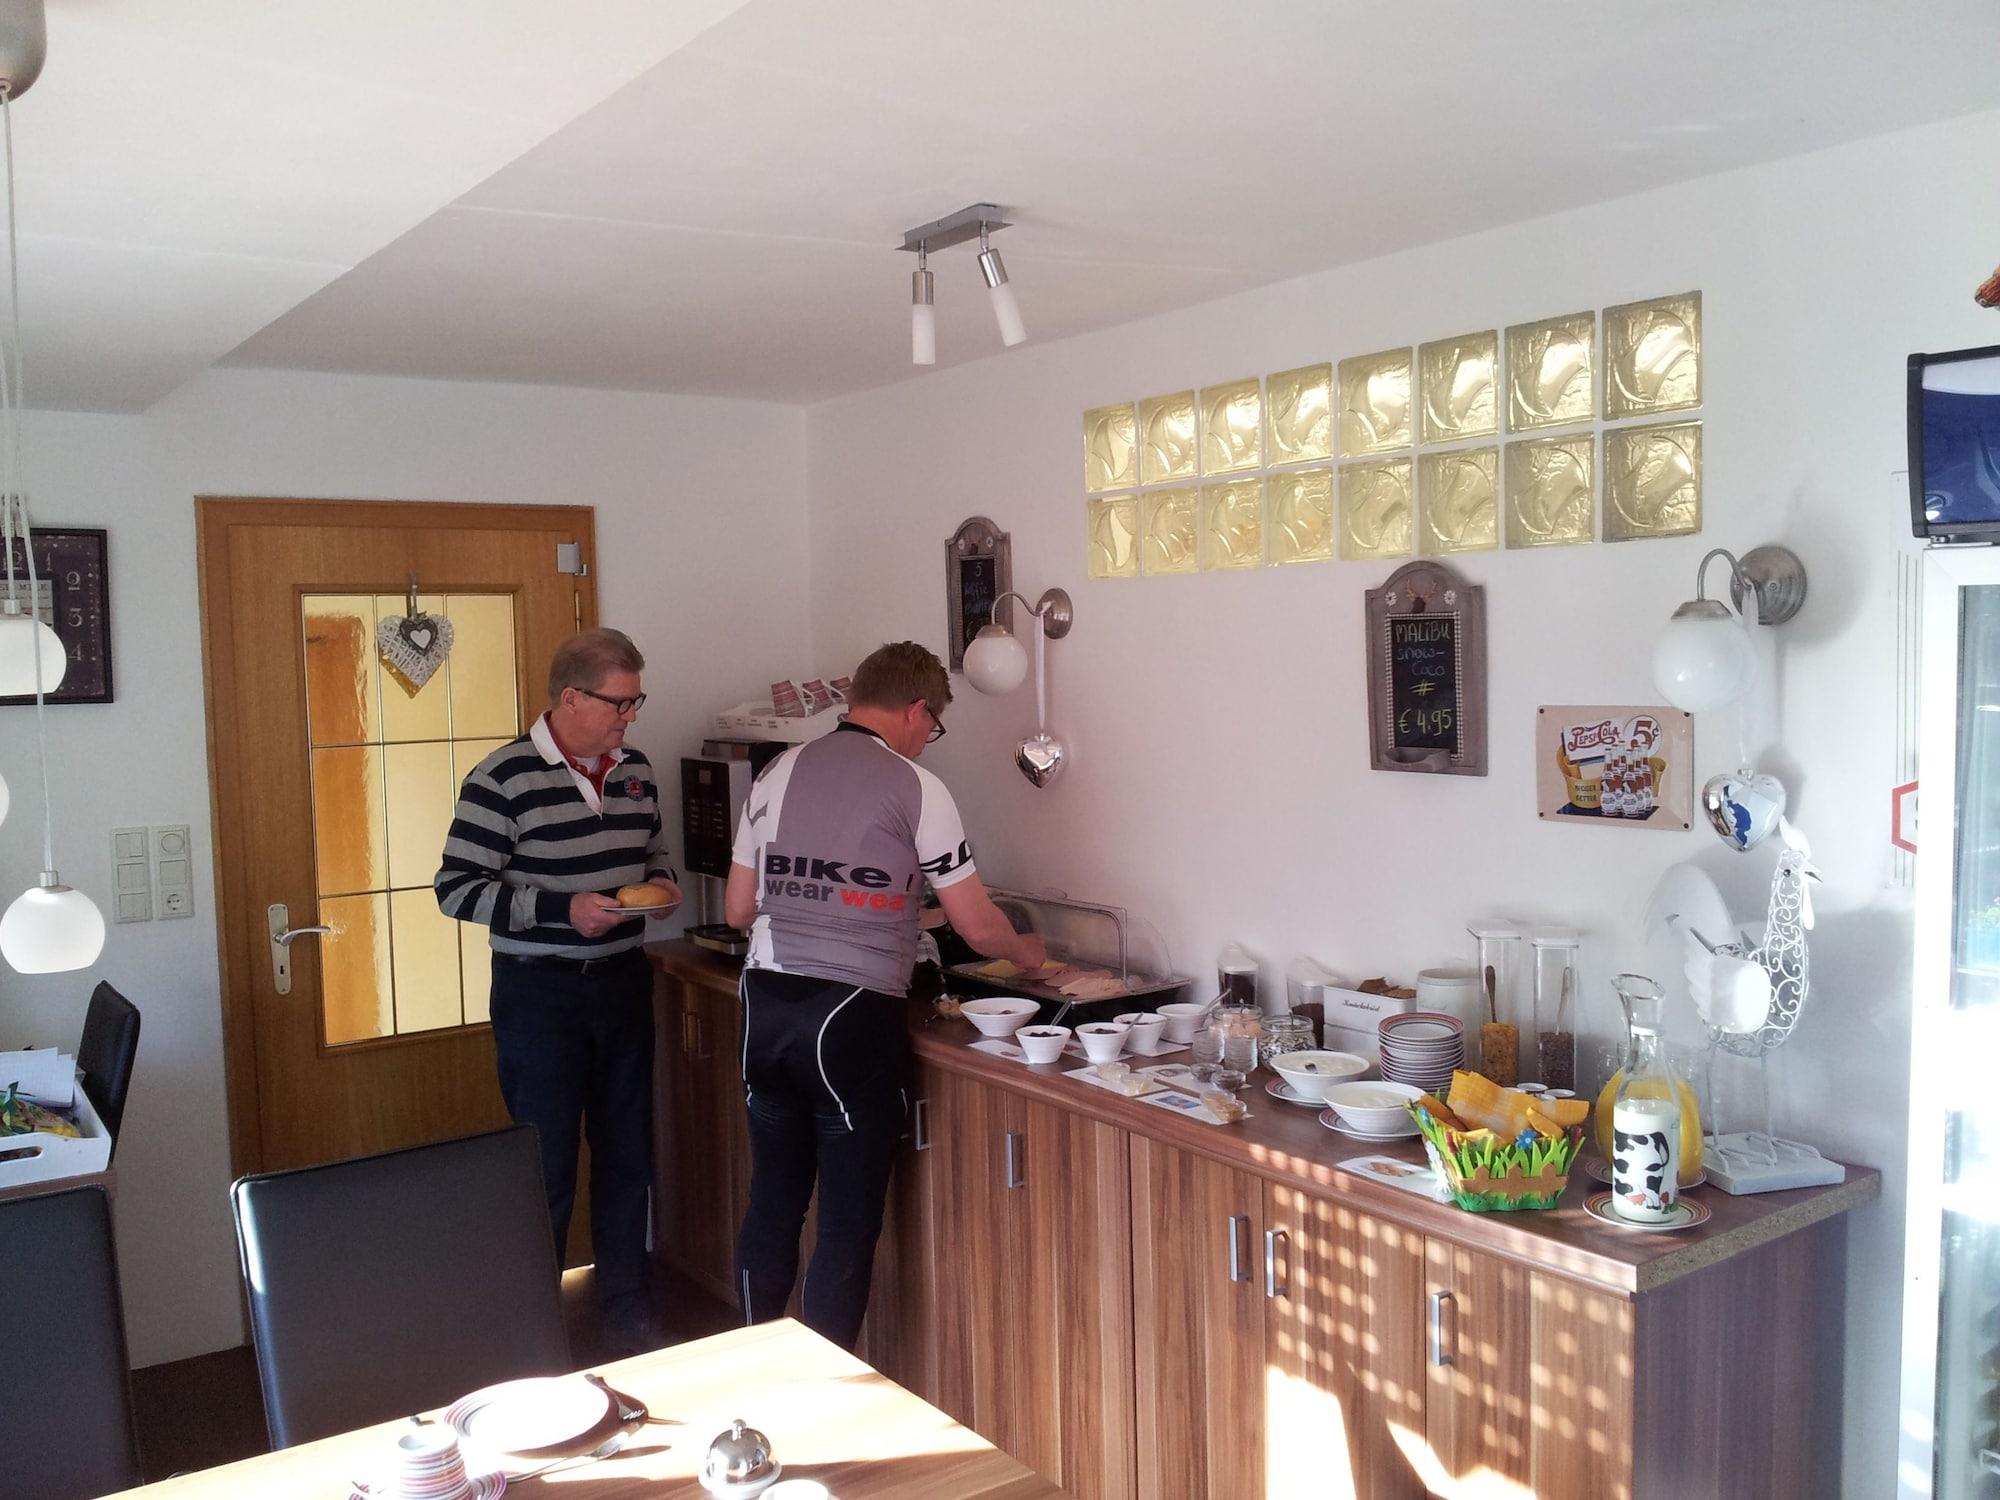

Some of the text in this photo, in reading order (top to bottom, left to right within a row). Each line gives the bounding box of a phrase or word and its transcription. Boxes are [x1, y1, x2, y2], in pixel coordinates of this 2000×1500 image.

[19, 583, 48, 591] MIK
[1416, 708, 1453, 737] 4.95
[765, 879, 834, 902] wear
